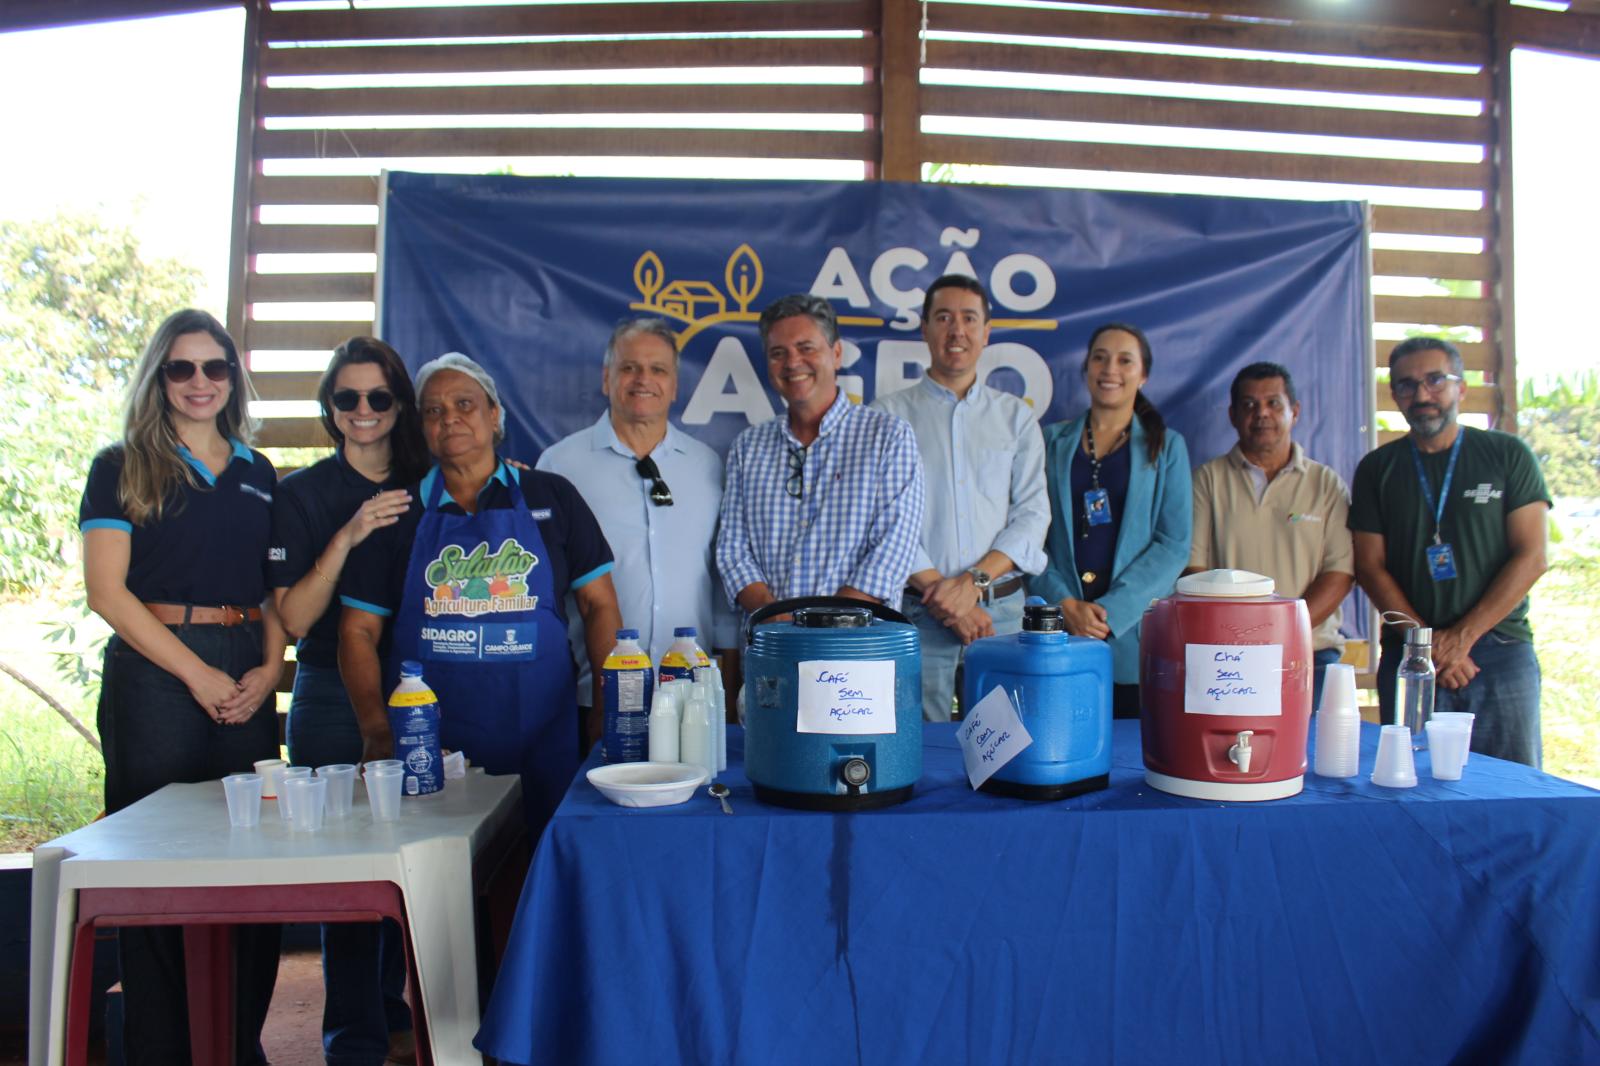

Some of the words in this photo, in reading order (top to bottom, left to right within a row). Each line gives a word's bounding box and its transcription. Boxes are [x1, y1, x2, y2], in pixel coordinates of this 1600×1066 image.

[424, 597, 493, 616] Agricultura
[493, 596, 537, 611] Familiar
[421, 627, 477, 642] SIDAGRO
[484, 644, 509, 652] CAMPO
[509, 643, 533, 651] GRANDE
